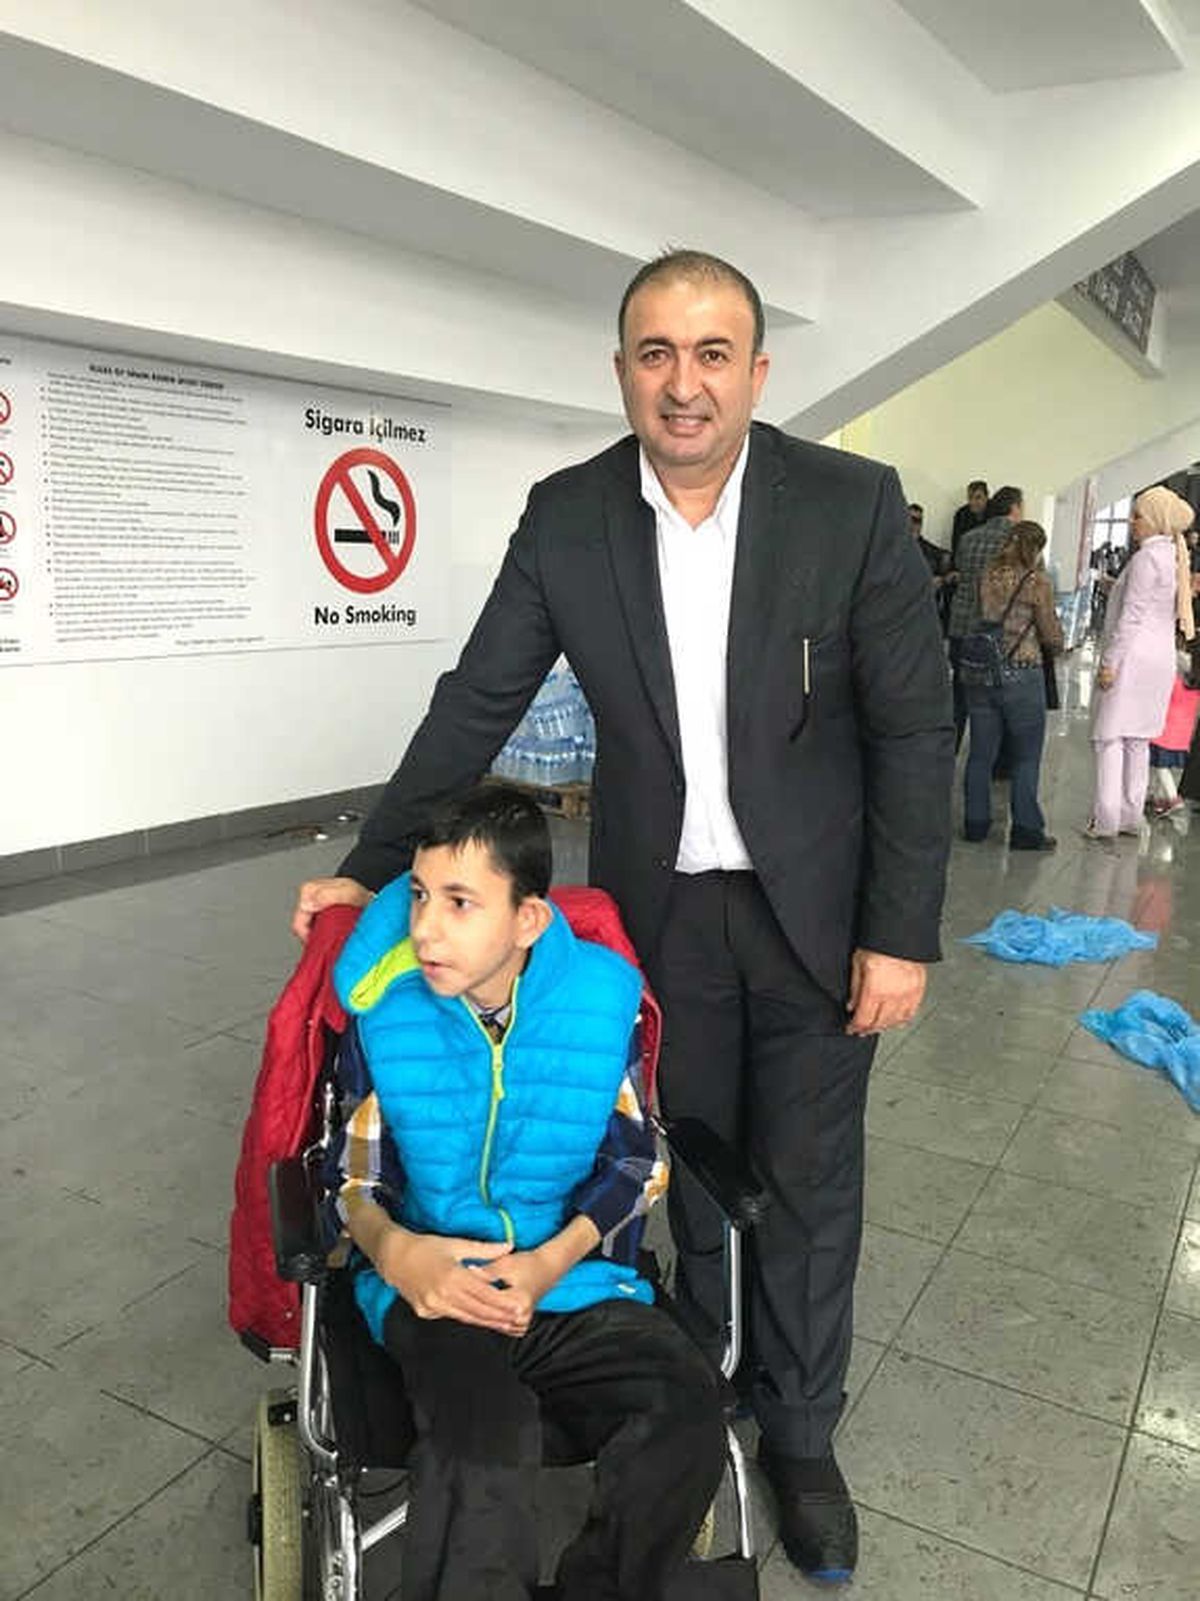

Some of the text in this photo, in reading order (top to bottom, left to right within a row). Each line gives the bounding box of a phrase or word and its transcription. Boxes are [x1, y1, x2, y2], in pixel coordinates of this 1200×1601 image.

[305, 409, 426, 443] Sigara İçilmez
[315, 604, 416, 626] No Smoking
